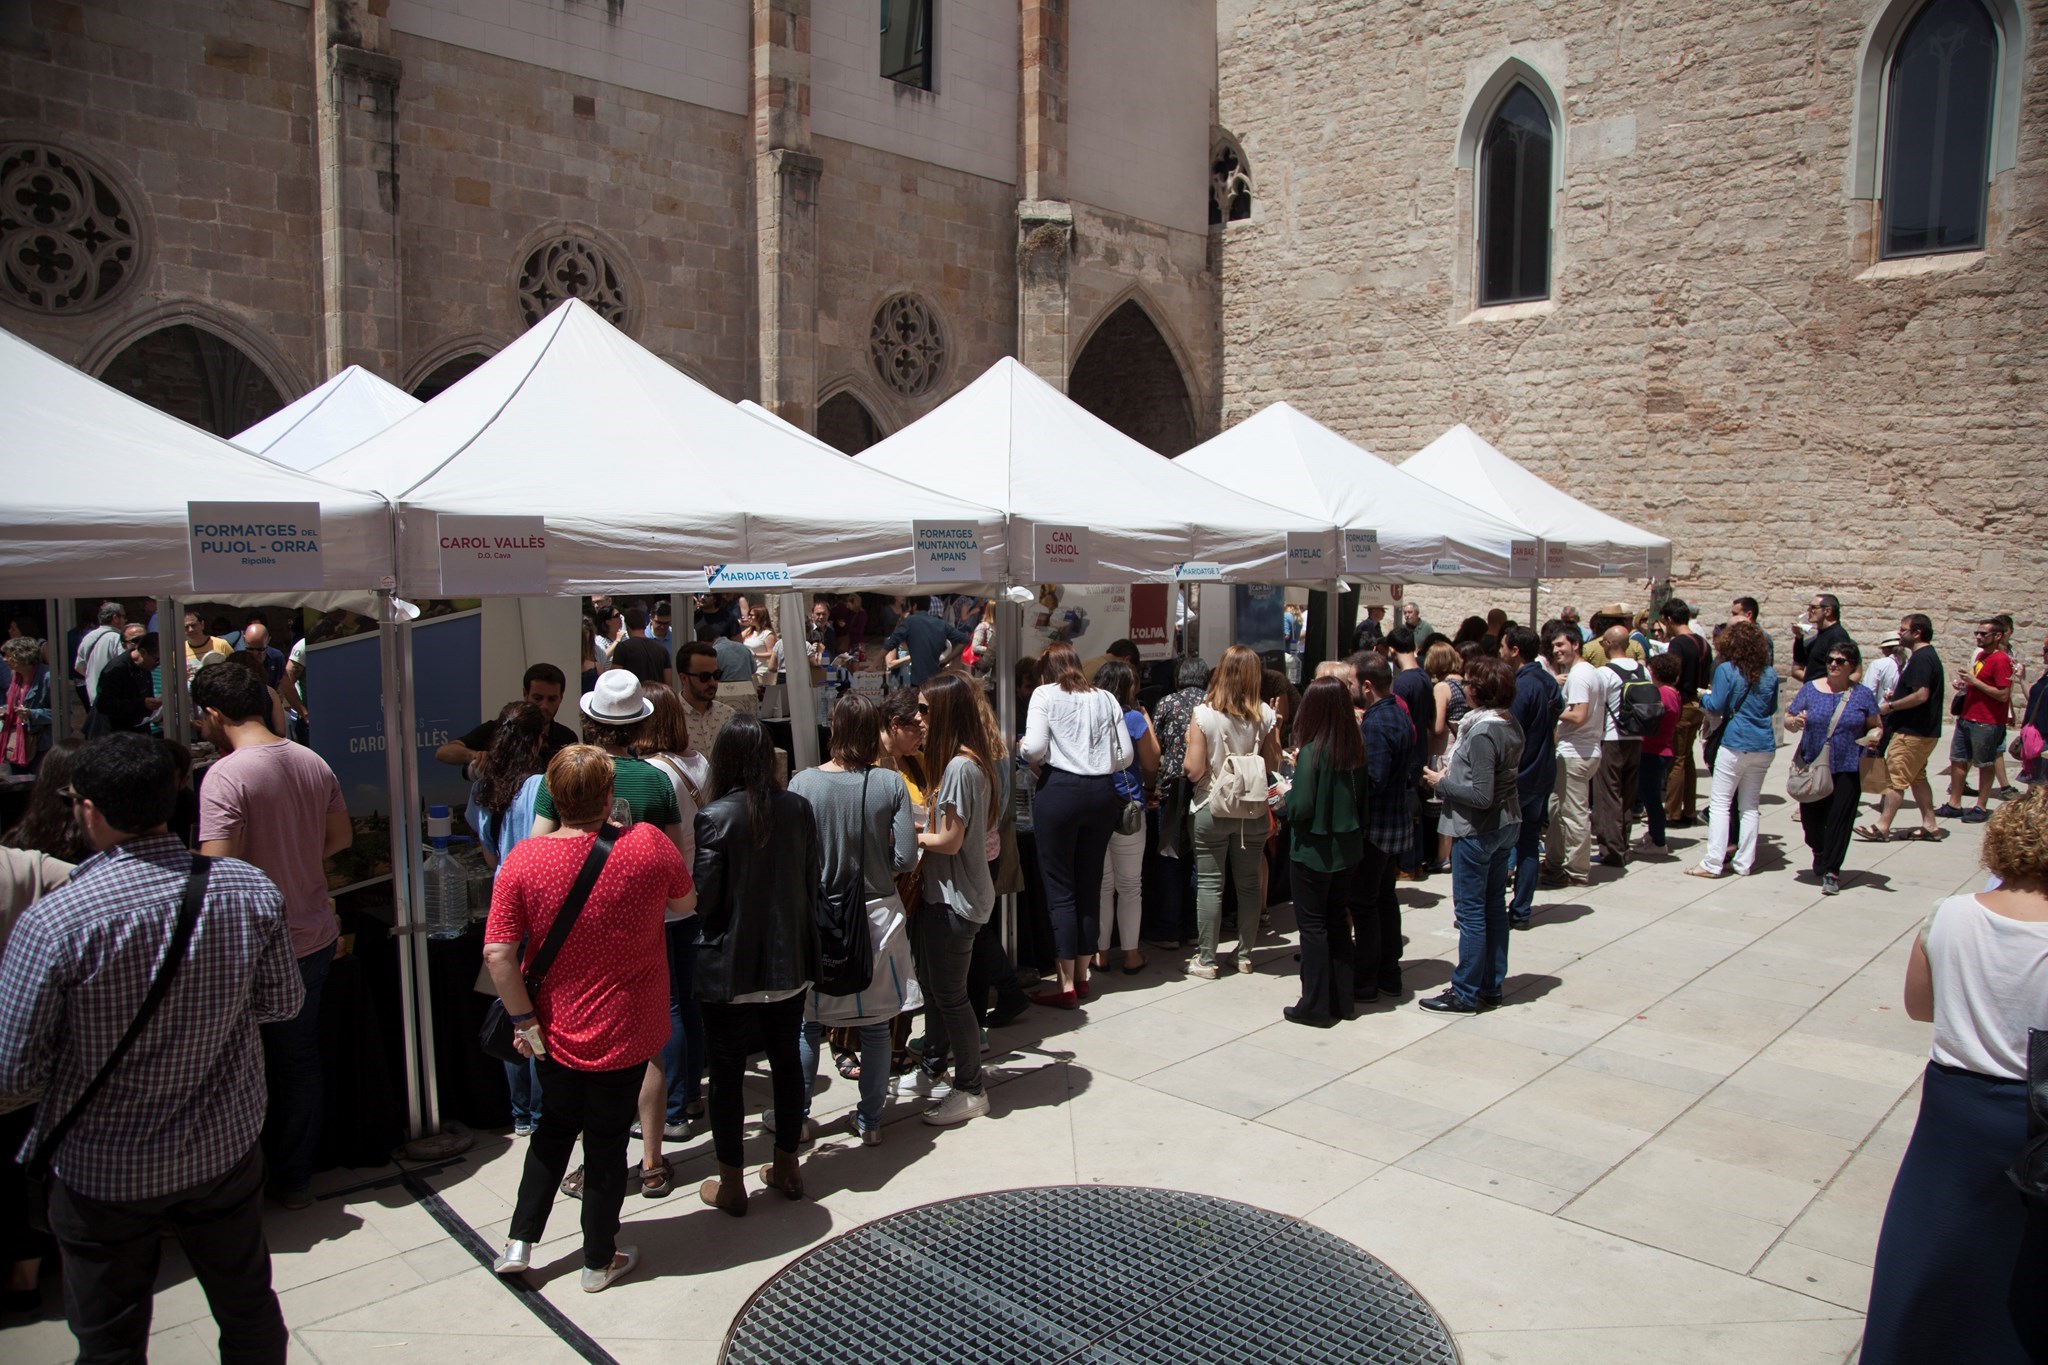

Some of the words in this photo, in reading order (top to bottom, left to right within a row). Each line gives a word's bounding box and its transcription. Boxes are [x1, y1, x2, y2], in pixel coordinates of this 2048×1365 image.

[194, 524, 297, 537] FORMATGES
[920, 529, 973, 538] FORMATGES
[440, 537, 490, 548] CAROL
[495, 534, 546, 548] VALLÈS
[1052, 531, 1073, 543] CAN
[1345, 534, 1377, 543] FORMATGES
[201, 541, 256, 553] PUJOL
[271, 540, 318, 552] ORRA
[917, 541, 978, 550] MUNTANYOLA
[1045, 544, 1080, 555] SURIOL
[930, 552, 967, 561] AMPANS
[1289, 549, 1321, 559] ARTELAC
[241, 557, 276, 565] Ripollès
[721, 572, 780, 582] MARIDATGE
[782, 571, 789, 580] 2
[1131, 627, 1165, 639] L'OLIVA
[350, 735, 386, 753] CARO
